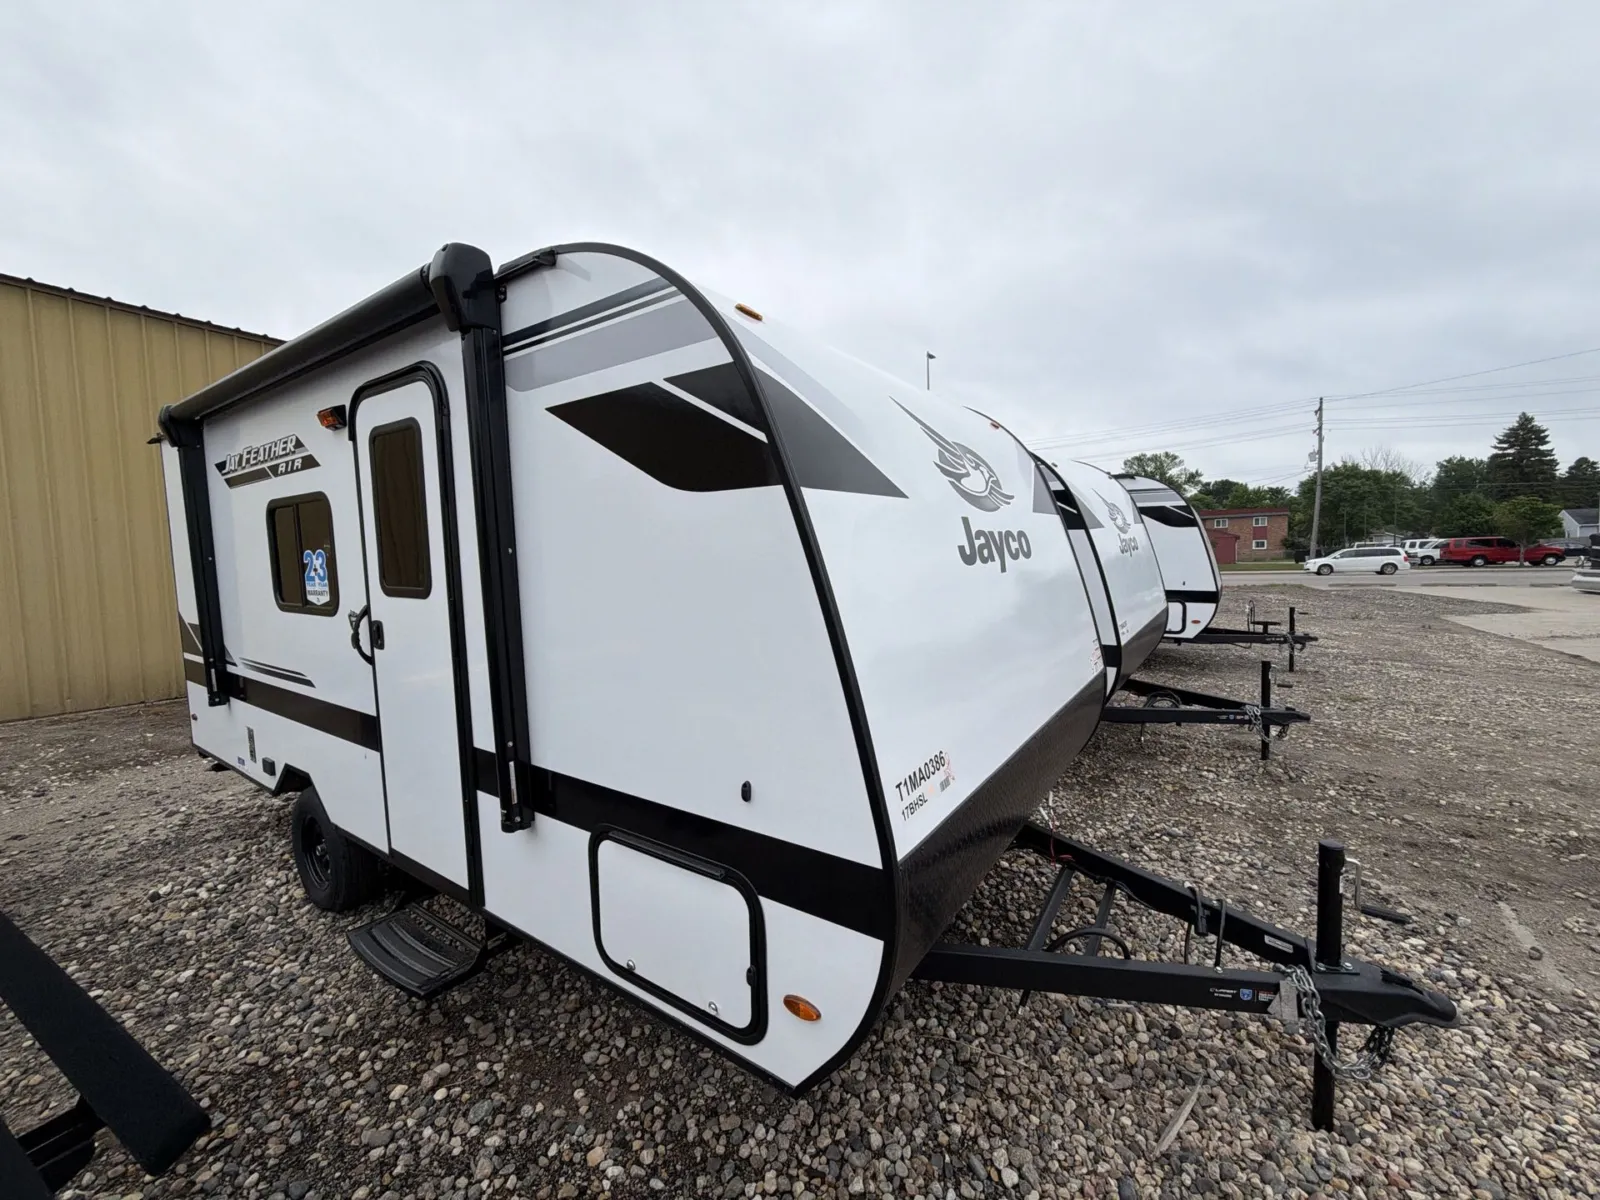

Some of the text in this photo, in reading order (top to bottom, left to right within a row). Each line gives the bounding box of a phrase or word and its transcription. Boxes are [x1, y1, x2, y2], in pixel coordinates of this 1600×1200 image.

[221, 435, 297, 475] JAY FEATHER
[278, 458, 302, 475] AIR
[957, 516, 1032, 573] Jayco
[895, 750, 946, 802] T1MA0386
[901, 792, 928, 822] 17BHSL
